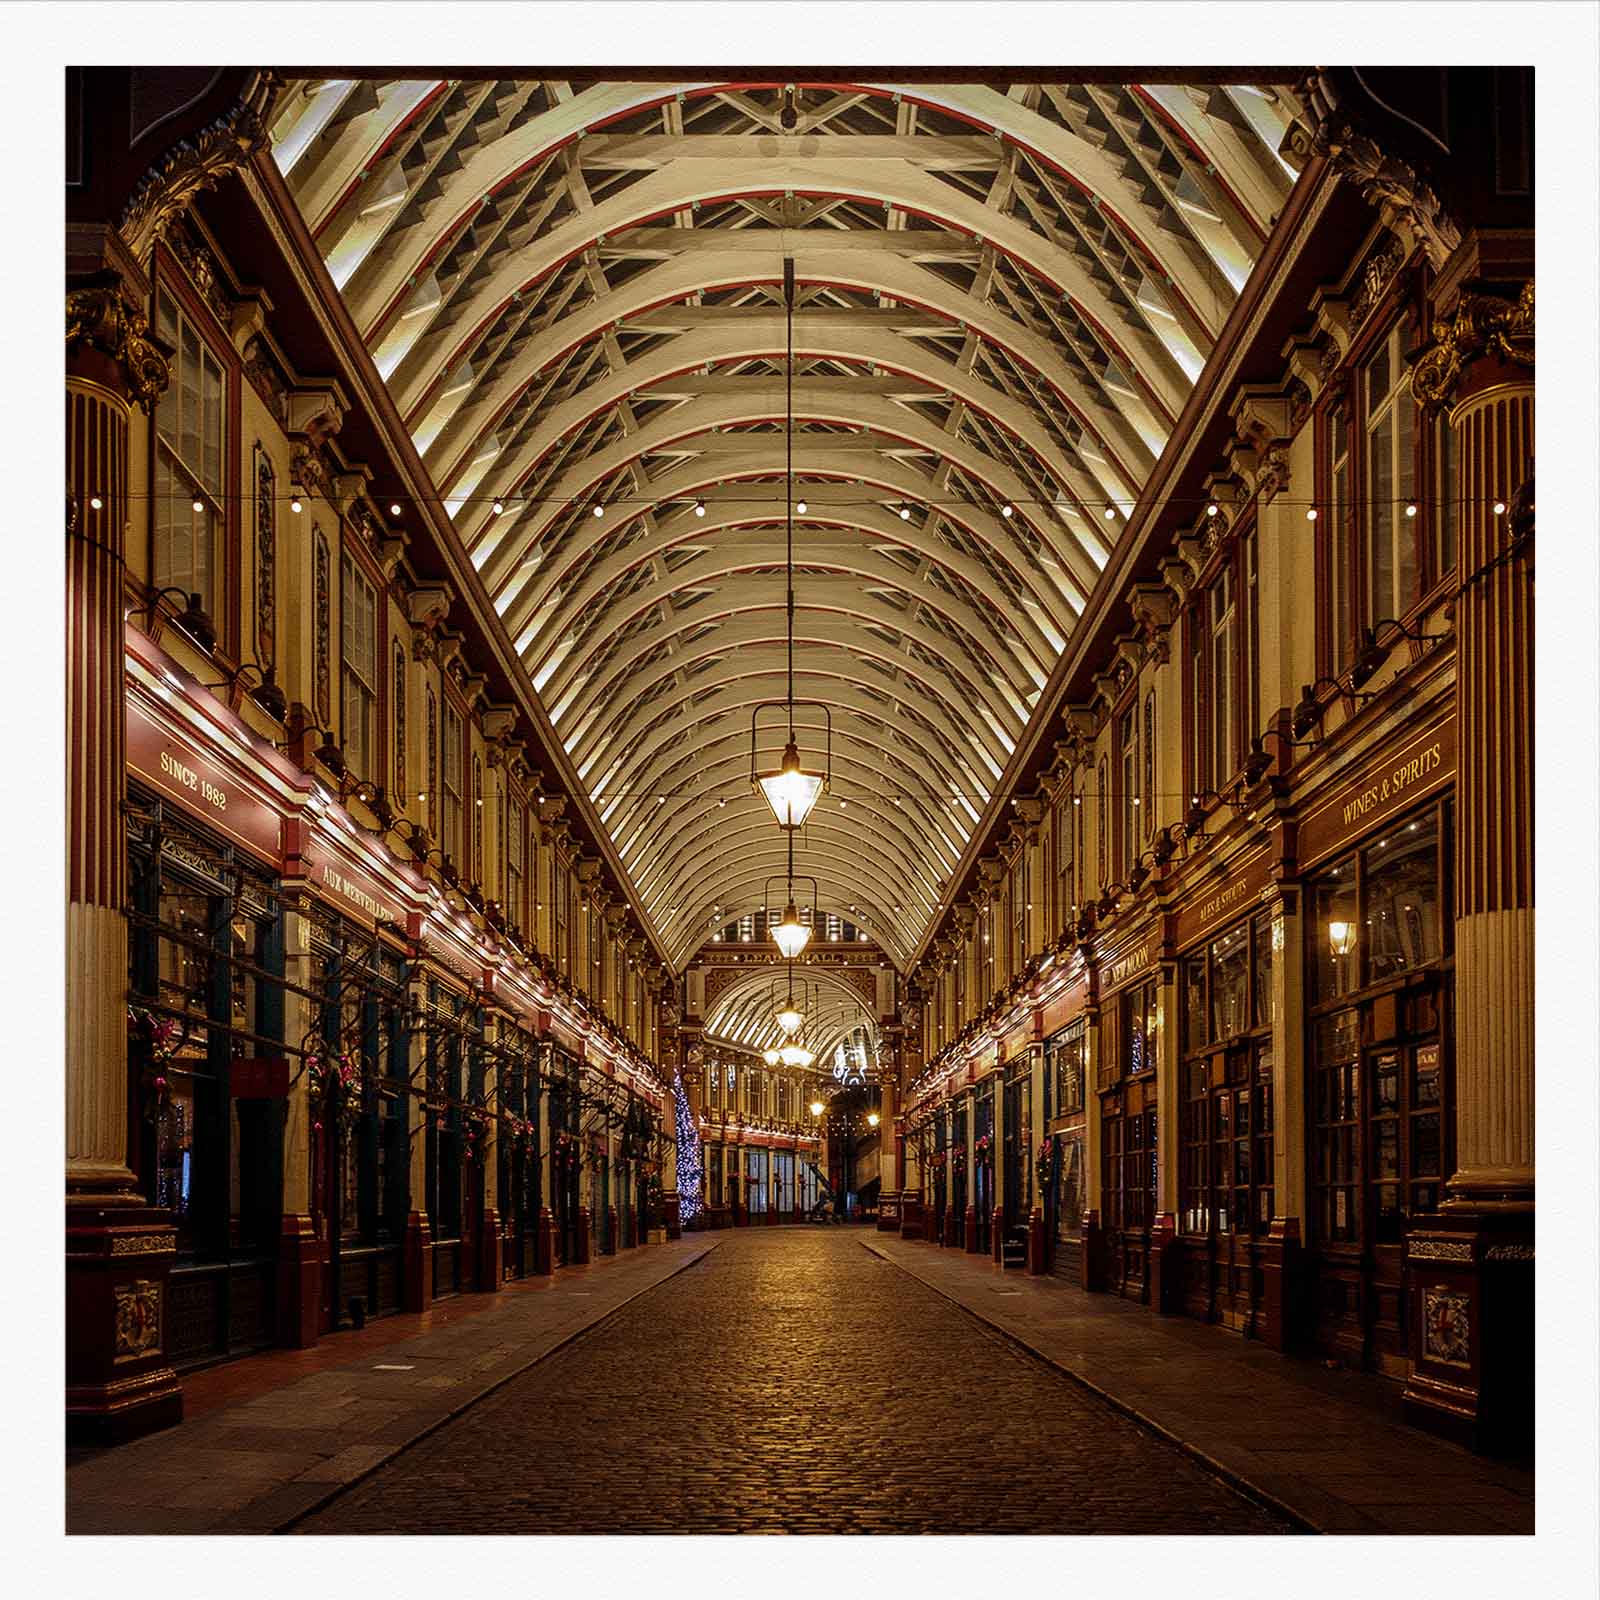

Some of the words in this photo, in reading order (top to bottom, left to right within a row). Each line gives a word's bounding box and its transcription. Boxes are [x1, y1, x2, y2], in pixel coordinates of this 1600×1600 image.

[161, 752, 197, 791] SINCE
[201, 780, 226, 811] 1882
[1343, 785, 1378, 825] WINES
[1380, 778, 1390, 802] &
[1392, 743, 1440, 793] SPIRITS
[323, 865, 342, 892] AUX
